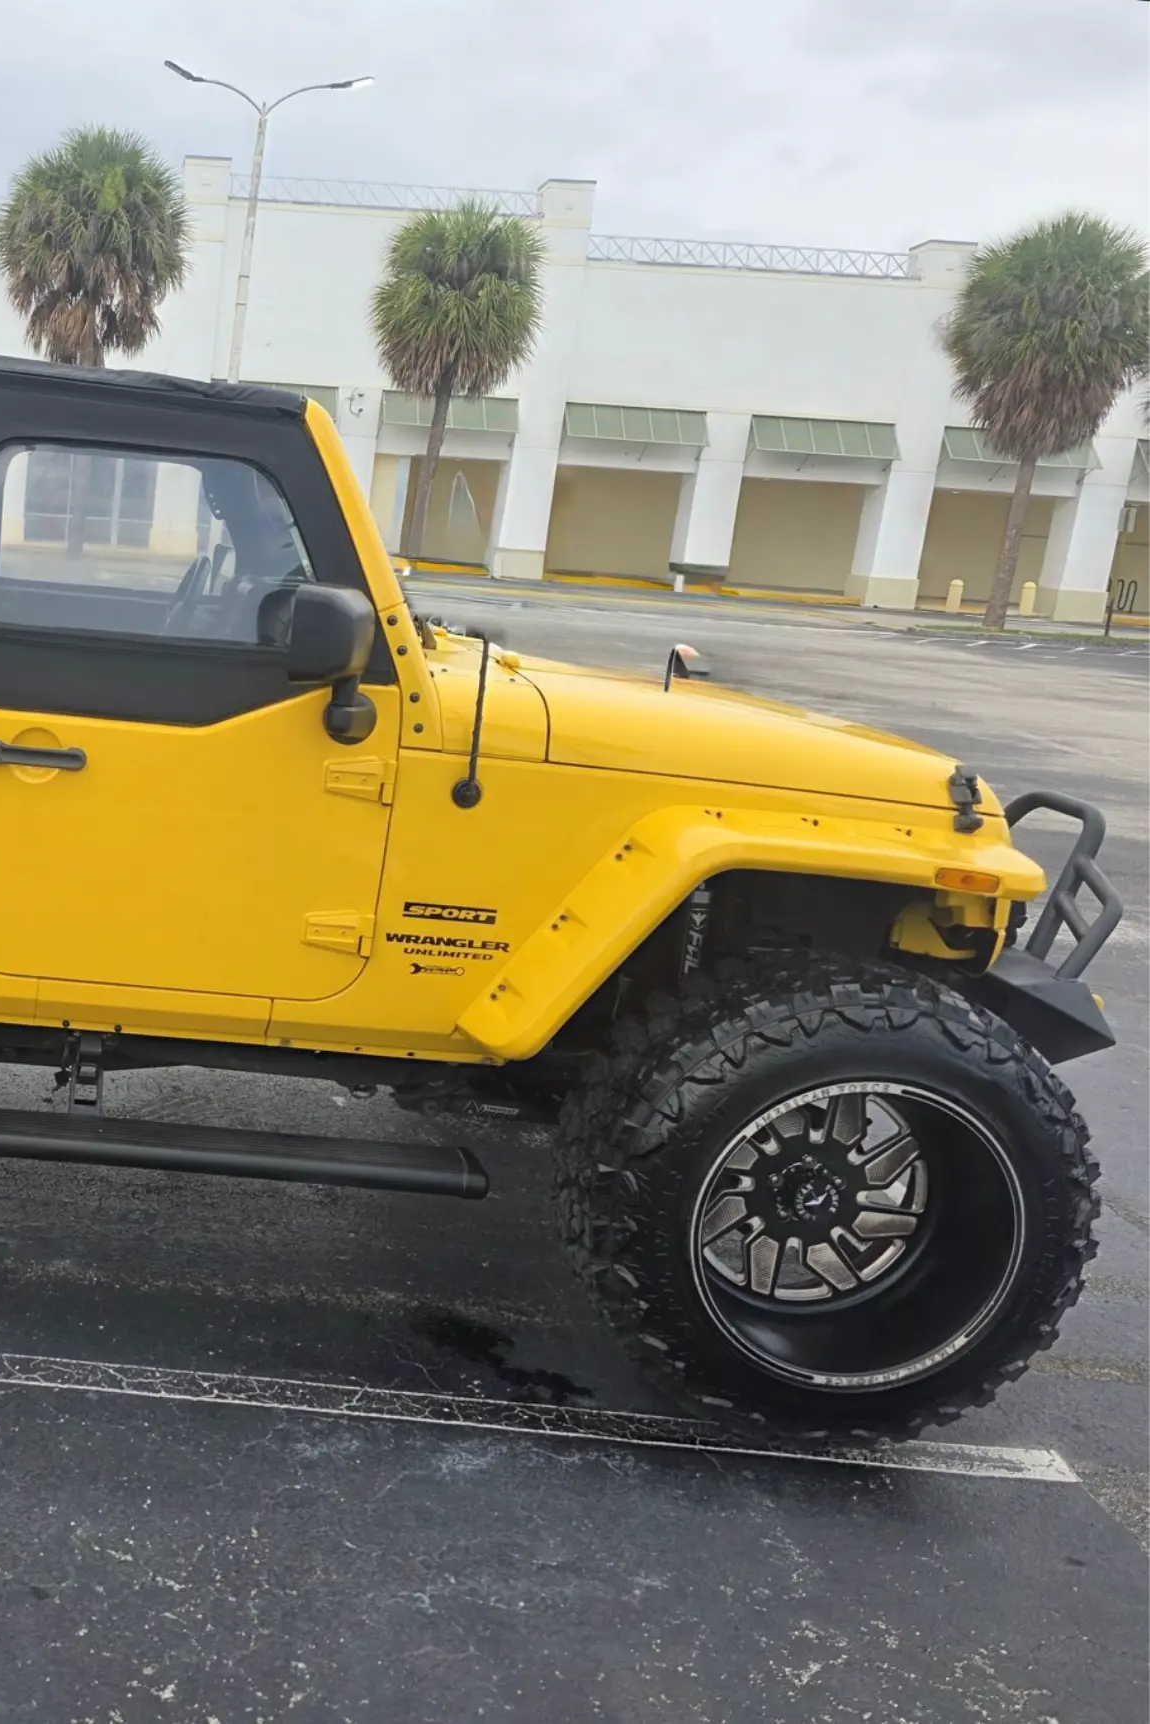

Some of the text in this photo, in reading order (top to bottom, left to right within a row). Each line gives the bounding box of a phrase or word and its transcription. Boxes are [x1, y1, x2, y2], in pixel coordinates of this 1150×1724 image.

[407, 904, 493, 922] SPORT
[385, 932, 510, 953] WRANGLER
[403, 947, 493, 961] UNLIMITED
